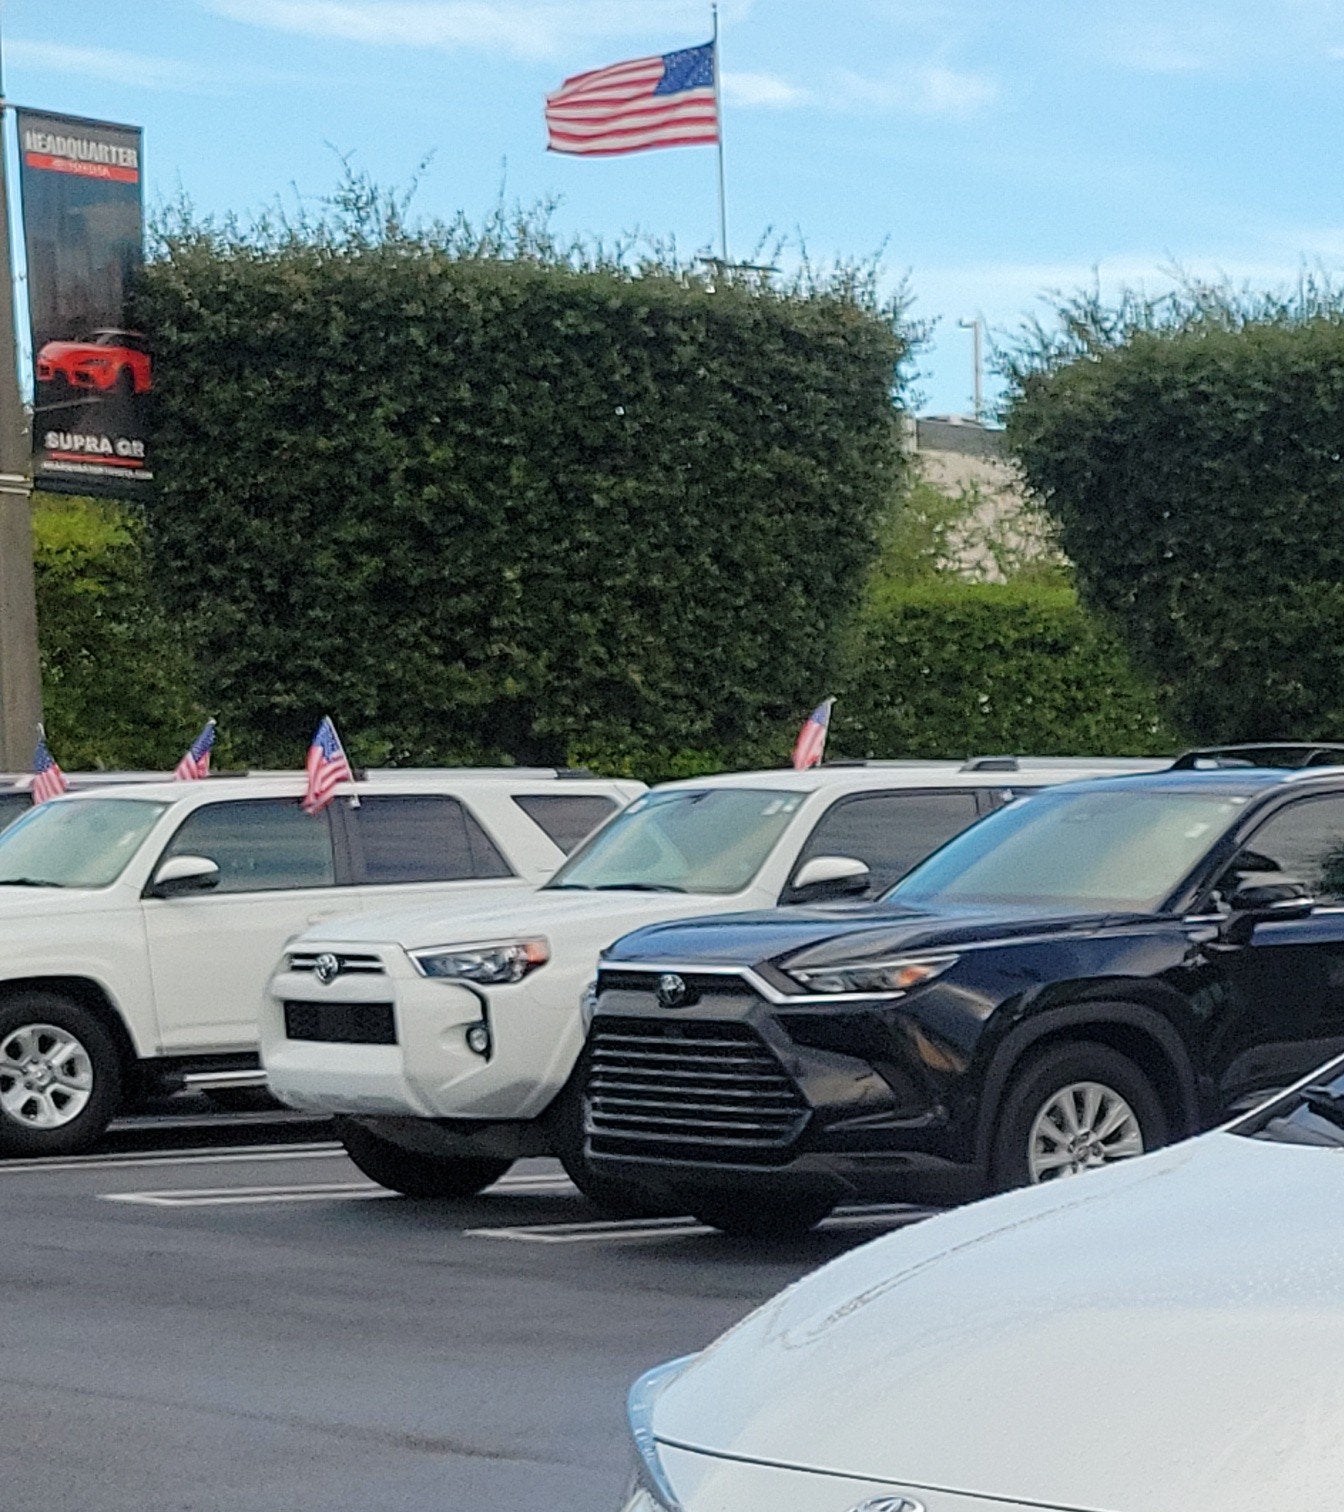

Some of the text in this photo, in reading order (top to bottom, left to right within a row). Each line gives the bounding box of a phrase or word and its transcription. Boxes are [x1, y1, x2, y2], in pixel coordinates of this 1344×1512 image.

[26, 130, 138, 168] HEADQUARTER
[45, 431, 145, 457] SUPRA GR
